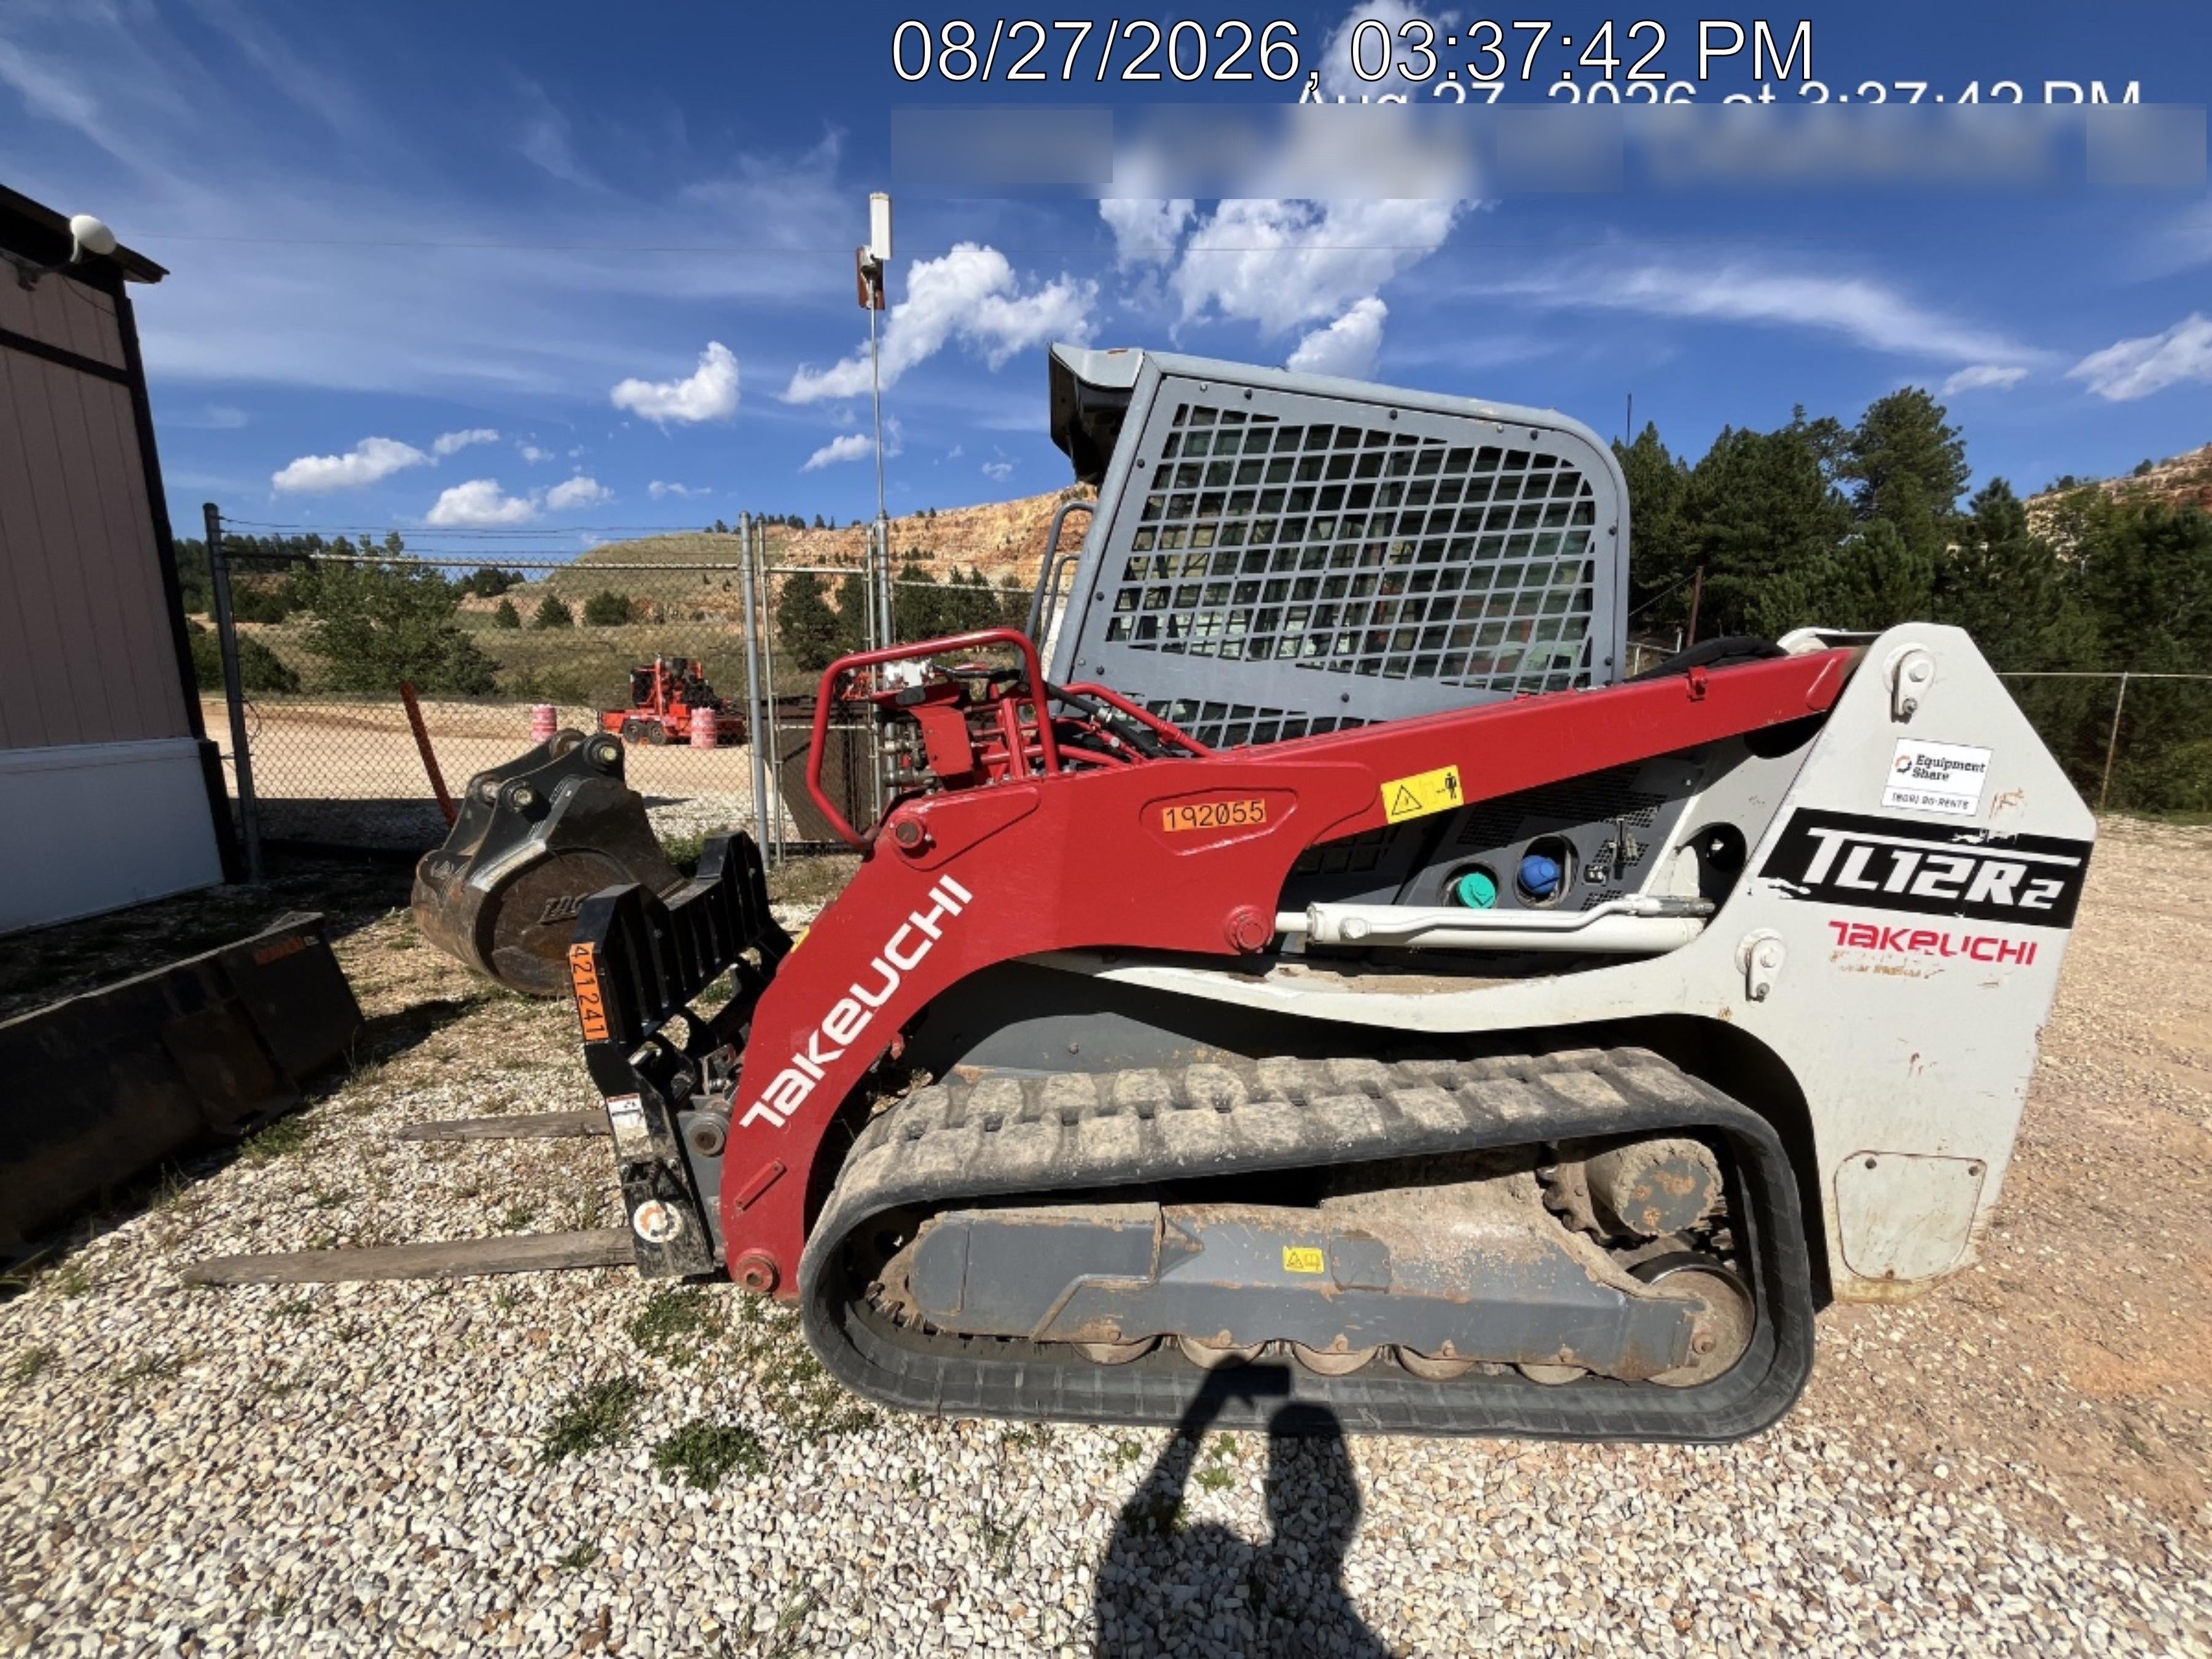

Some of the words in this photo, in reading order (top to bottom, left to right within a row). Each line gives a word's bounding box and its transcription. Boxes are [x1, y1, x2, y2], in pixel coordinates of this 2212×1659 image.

[1911, 766, 1949, 781] Share
[1915, 753, 1986, 772] Equipment
[1166, 799, 1264, 829] 192055
[571, 945, 605, 1033] 421241
